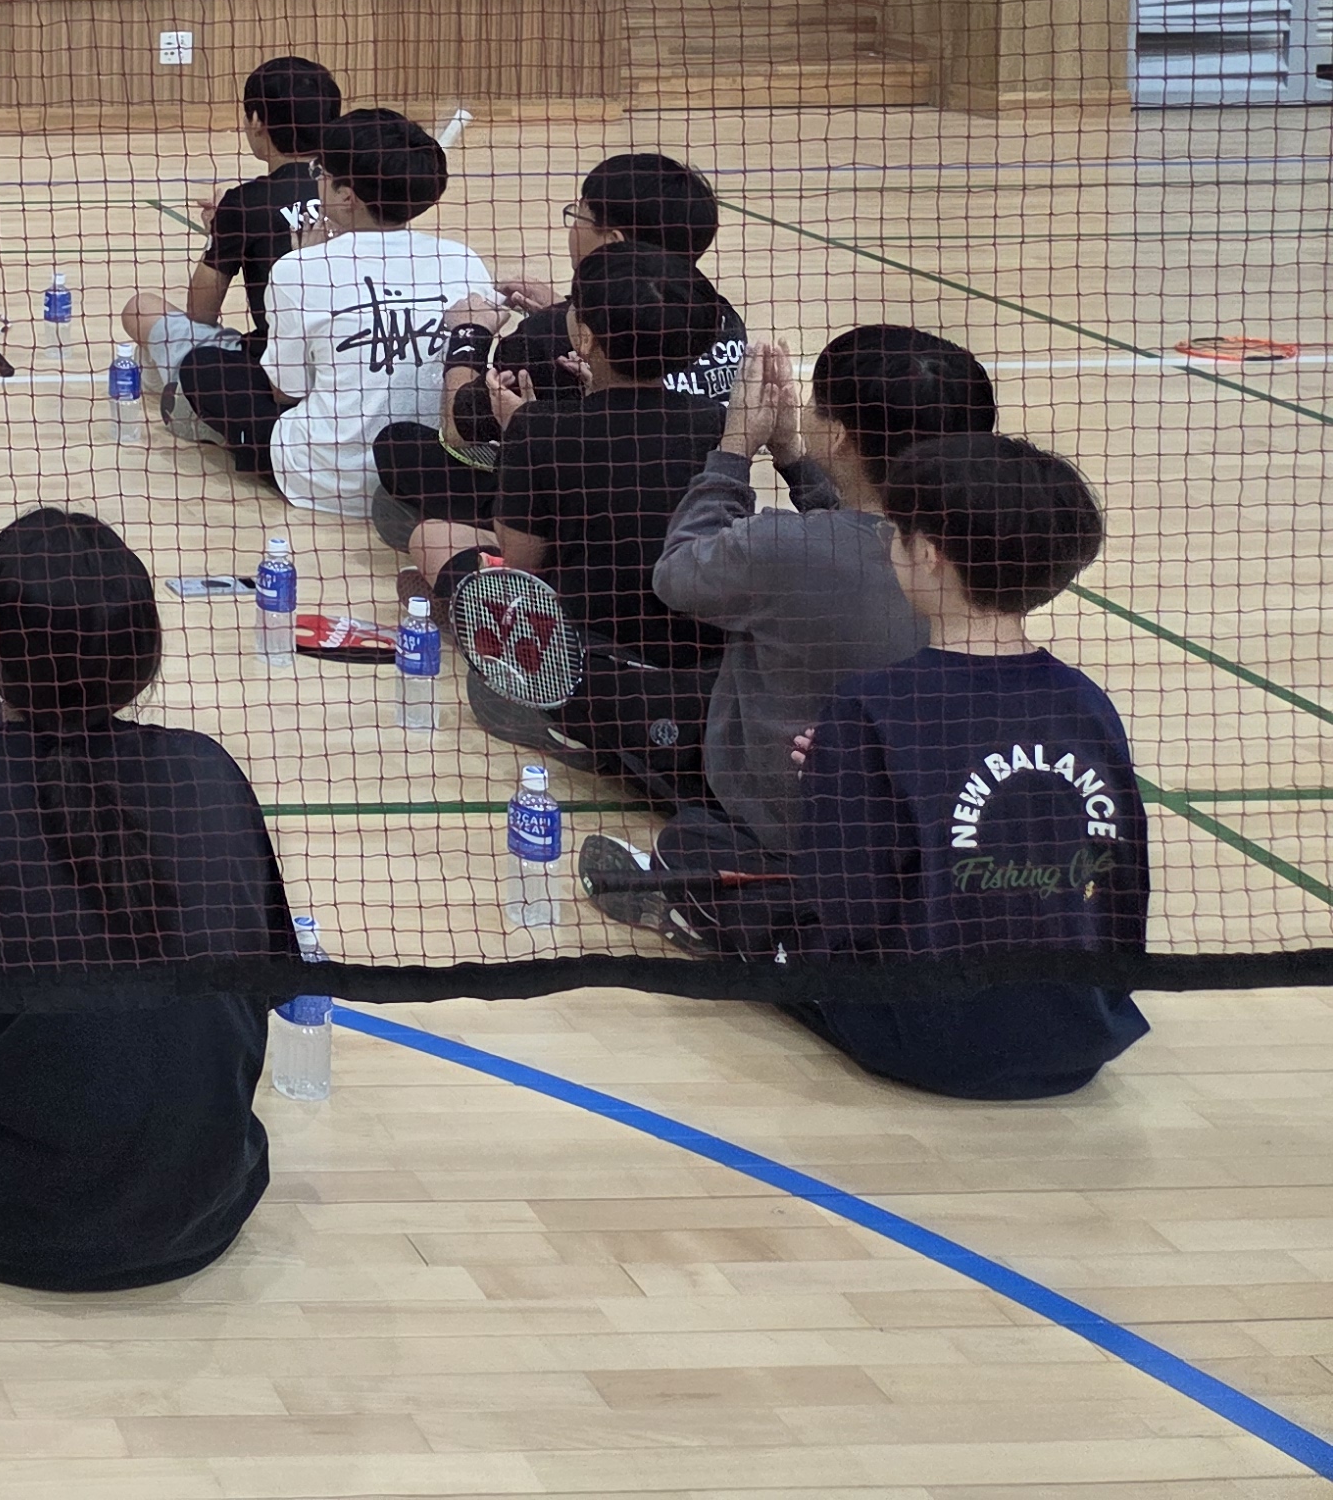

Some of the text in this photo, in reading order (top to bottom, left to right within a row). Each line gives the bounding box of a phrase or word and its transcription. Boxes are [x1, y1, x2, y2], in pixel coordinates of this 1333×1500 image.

[951, 743, 1117, 848] NEW BALANCE
[952, 856, 1064, 899] Fishing
